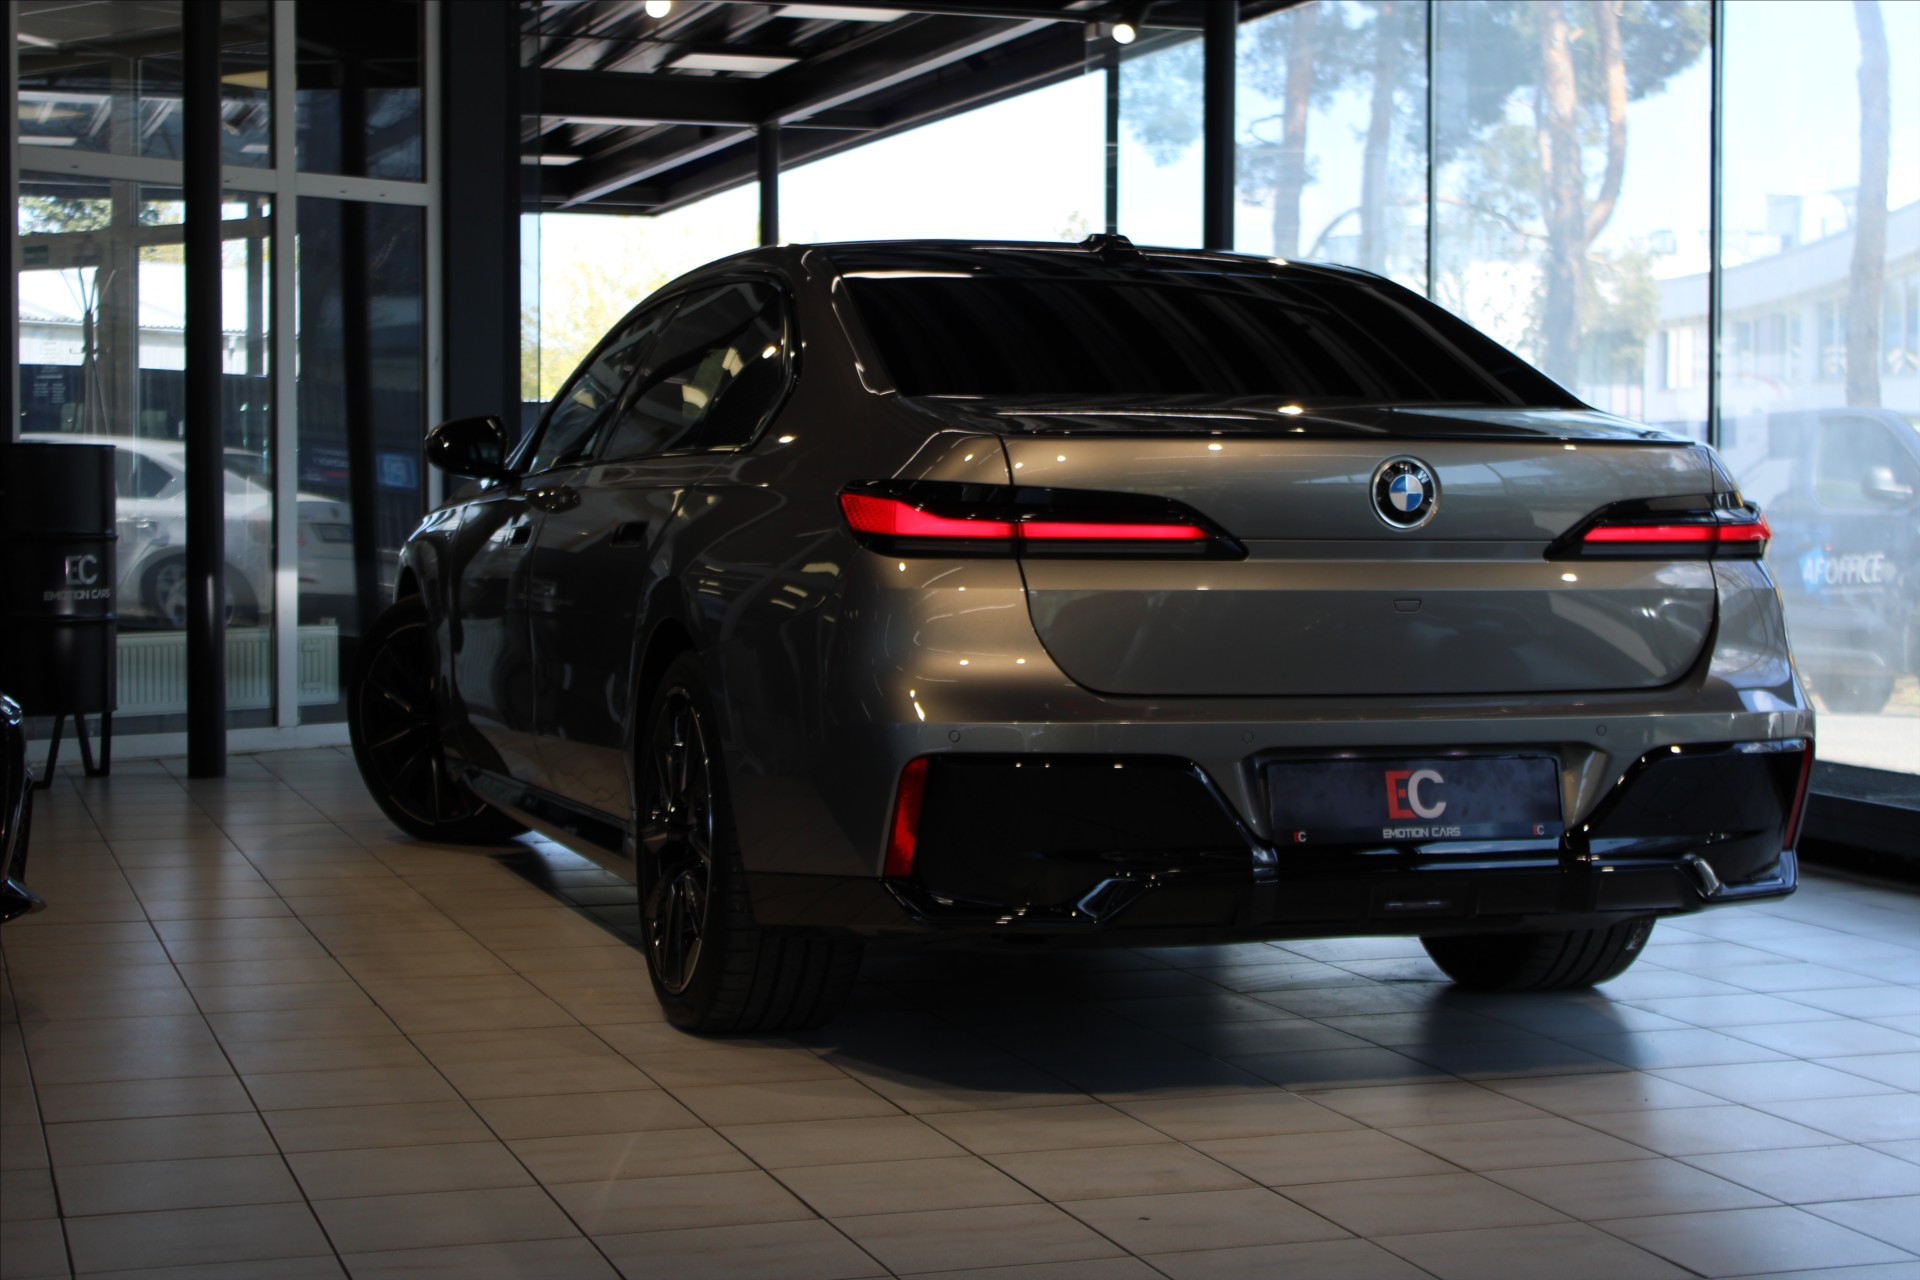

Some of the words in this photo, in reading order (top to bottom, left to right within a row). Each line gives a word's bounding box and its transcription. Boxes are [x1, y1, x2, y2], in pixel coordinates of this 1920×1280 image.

[1382, 463, 1430, 484] BMW
[65, 554, 98, 585] EC
[43, 590, 90, 601] EMOTION
[91, 588, 111, 599] CARS
[1385, 769, 1446, 819] EC
[1382, 827, 1429, 839] EMOTION
[1431, 827, 1461, 837] CARS
